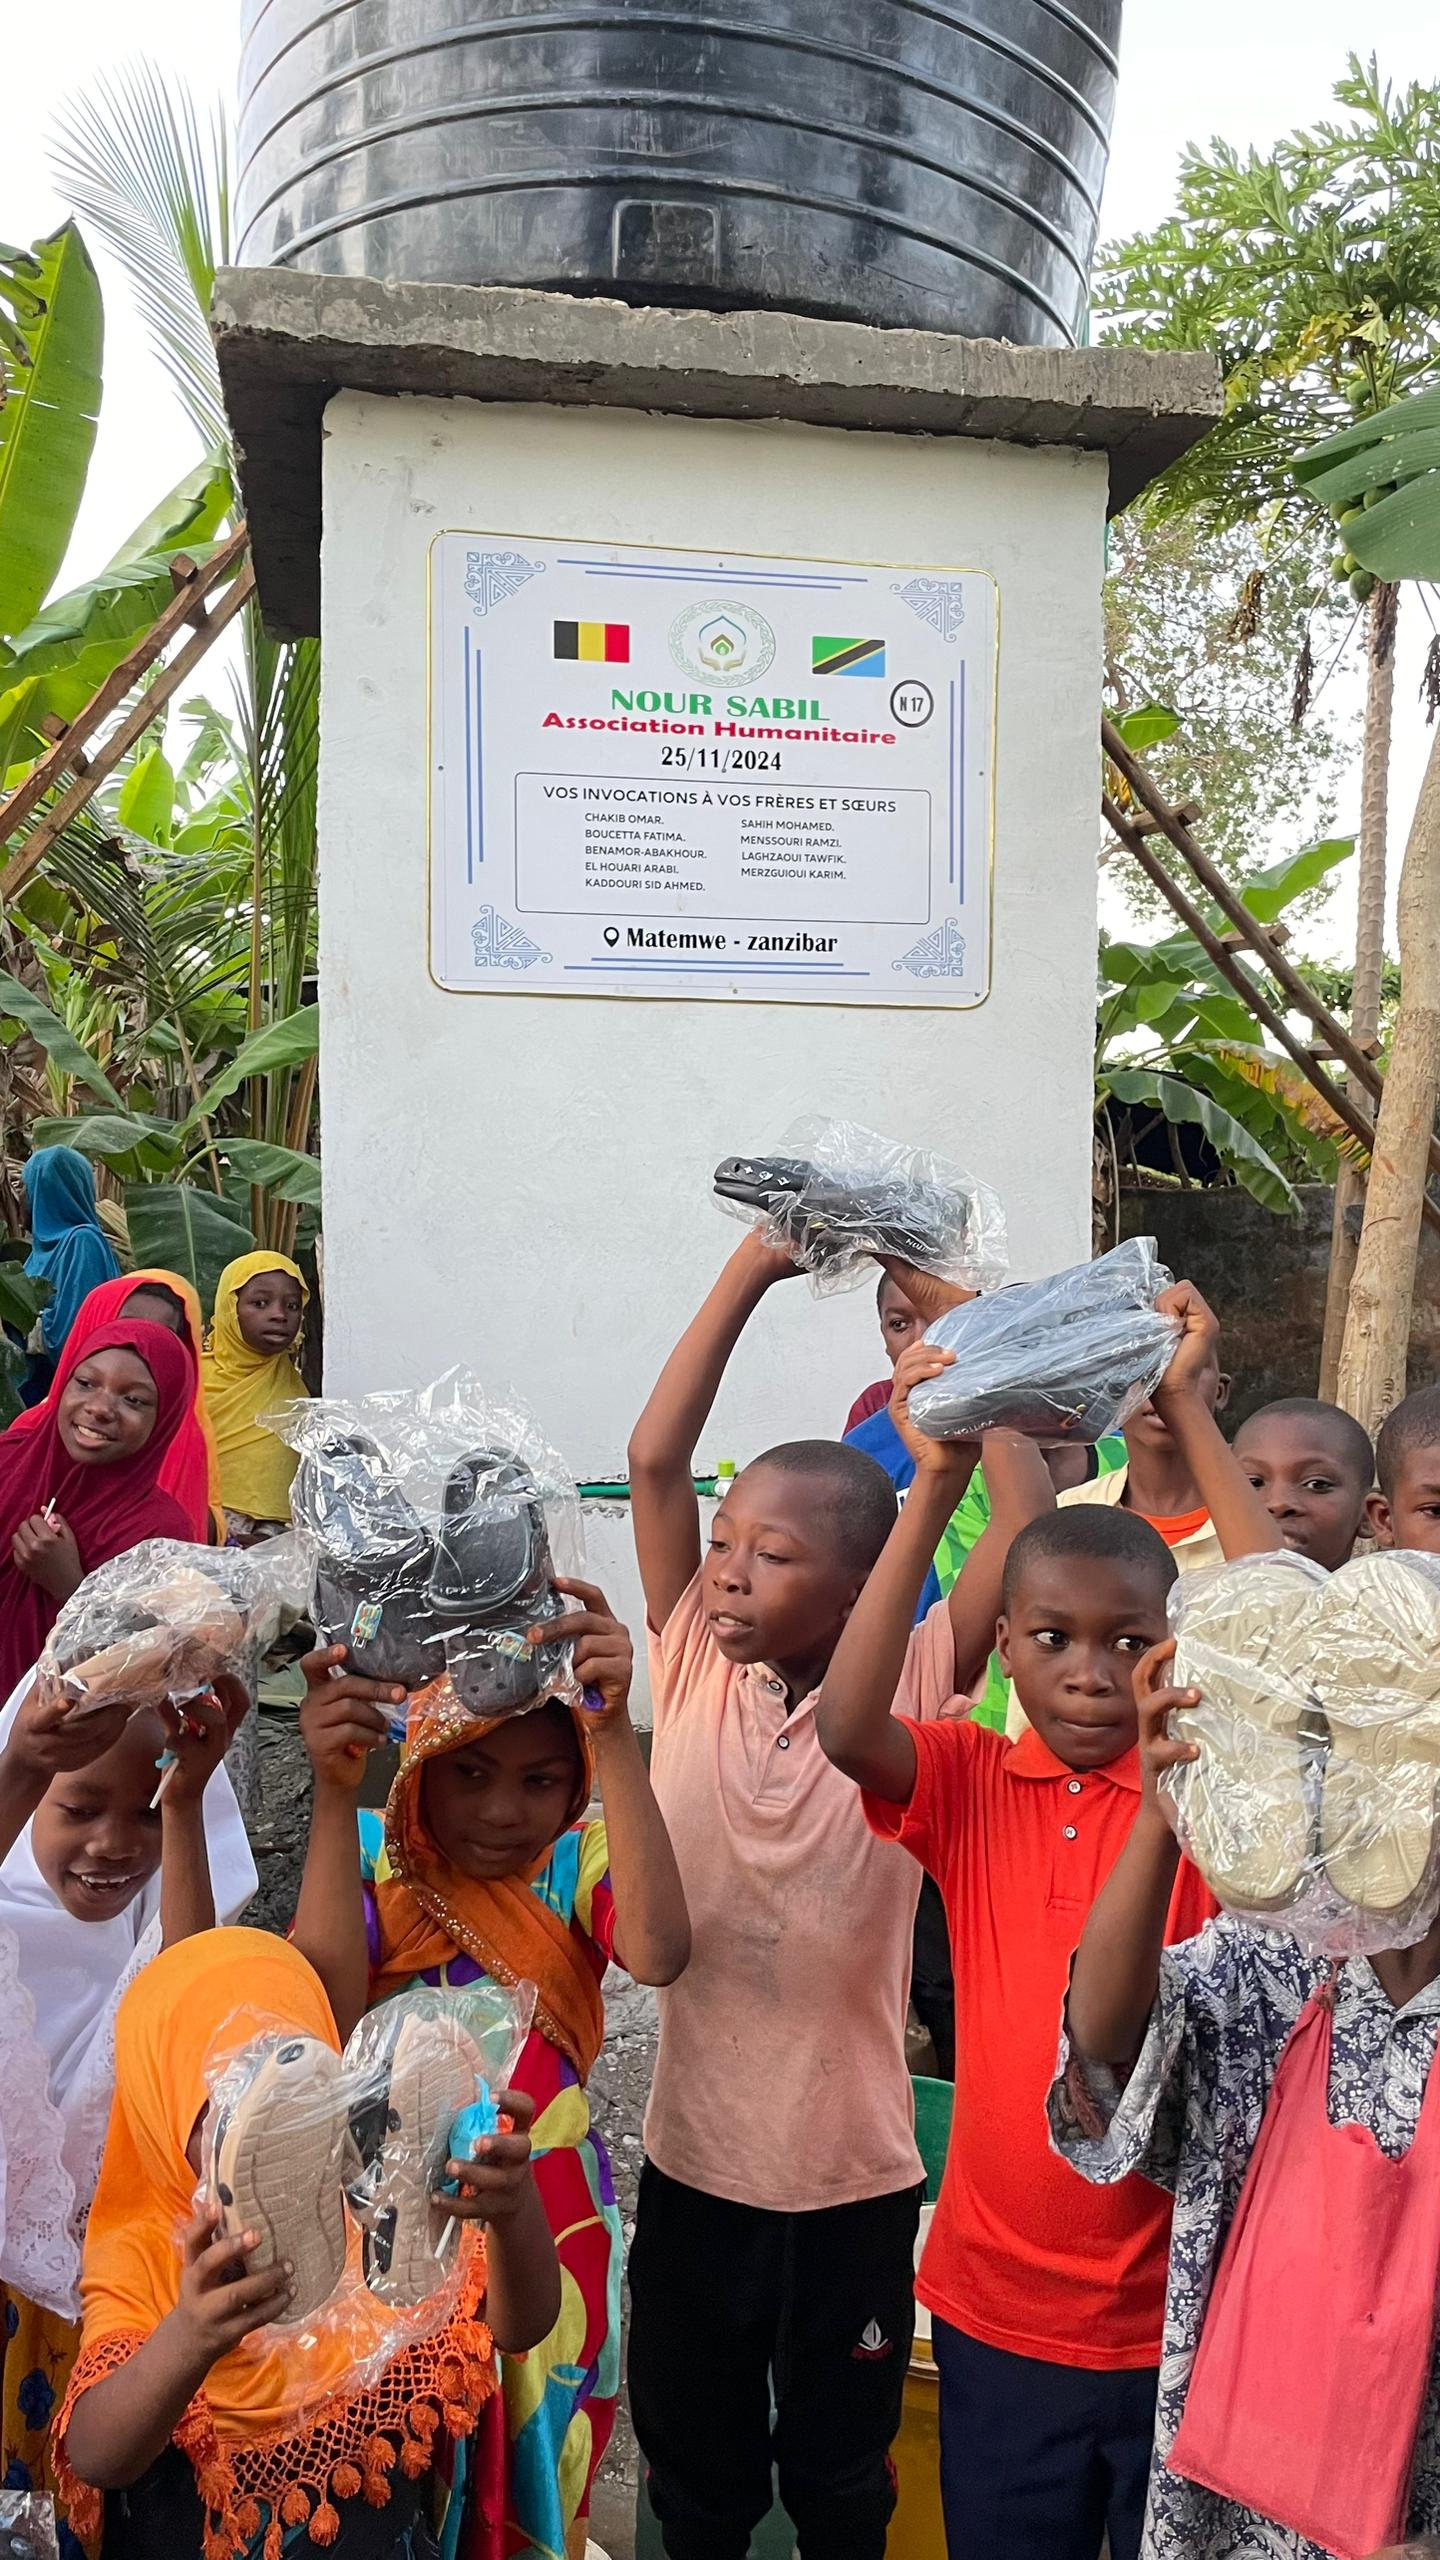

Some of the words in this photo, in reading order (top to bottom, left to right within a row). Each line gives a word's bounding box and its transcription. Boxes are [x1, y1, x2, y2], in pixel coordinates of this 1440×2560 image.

[612, 689, 712, 715] NOUR
[726, 696, 830, 721] SABIL
[911, 697, 924, 712] 17
[542, 712, 705, 736] Association
[714, 721, 896, 745] Humanitaire
[661, 746, 782, 772] 25/11/2024
[543, 786, 578, 799] VOS
[583, 788, 698, 804] INVOCATIONS
[702, 791, 713, 805] À
[717, 794, 751, 807] VOS
[755, 793, 815, 810] FRÈRES
[819, 798, 837, 810] ET
[841, 799, 897, 813] SŒURS
[584, 813, 626, 823] CHAKIB
[628, 815, 664, 825] OMAR.
[741, 819, 774, 829] SAHIH
[775, 820, 835, 832] MOHAMED.
[585, 829, 641, 840] BOUCETTA
[643, 831, 686, 842] FATIMA.
[740, 835, 803, 846] MENSSOURI
[805, 838, 842, 848] RAMZI.
[585, 845, 707, 859] BENAMOR-ABAKHOUR.
[741, 851, 802, 863] LAGHZAOUI
[804, 853, 847, 864] TAWFIK.
[585, 862, 598, 871] EL
[600, 862, 641, 872] HOUARI
[643, 864, 679, 874] ARABI.
[741, 867, 807, 879] MERZGUIOUI
[809, 870, 847, 880] KARIM.
[585, 878, 642, 889] KADDOURI
[644, 880, 662, 890] SID
[664, 881, 706, 891] AHMED.
[627, 927, 727, 950] Matemwe
[747, 932, 838, 953] zanzibar
